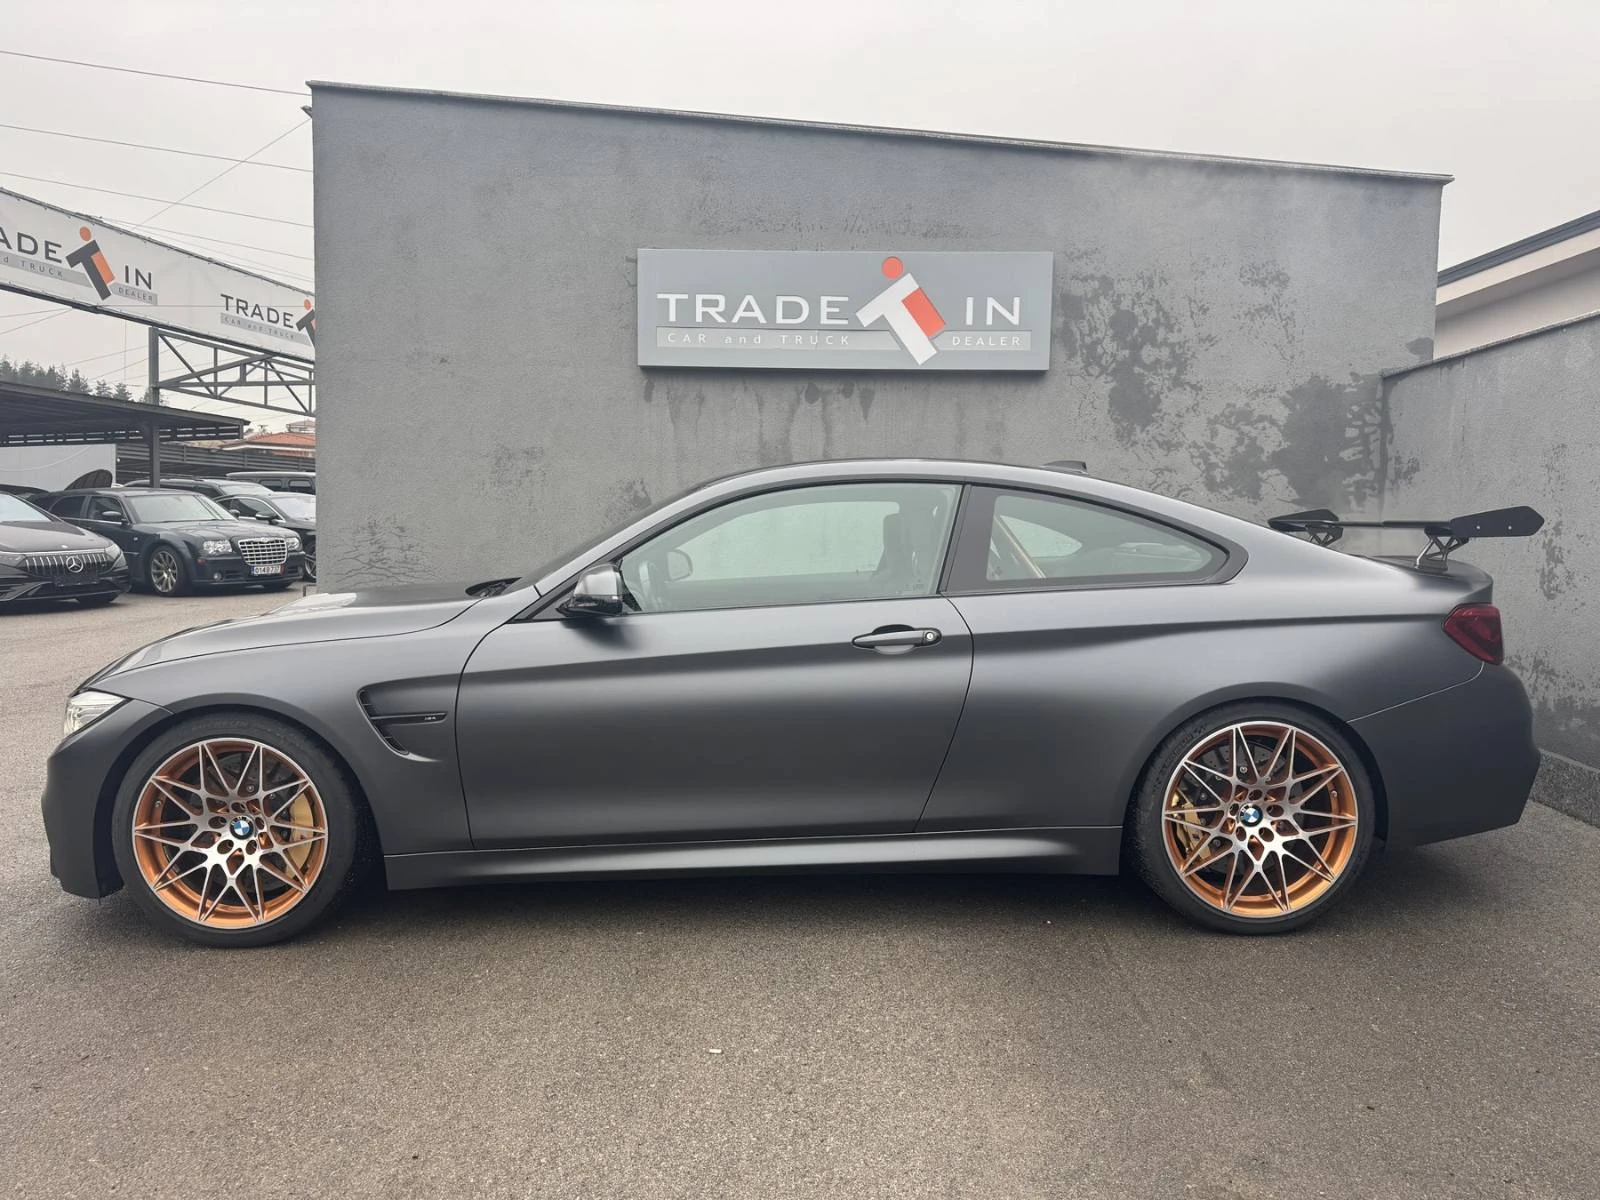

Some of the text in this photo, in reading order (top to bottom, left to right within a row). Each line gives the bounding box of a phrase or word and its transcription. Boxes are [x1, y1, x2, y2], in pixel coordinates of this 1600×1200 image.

[19, 260, 63, 279] TRUCK
[118, 287, 153, 302] DEALER
[124, 265, 152, 290] IN
[220, 293, 293, 329] TRADE
[656, 292, 849, 325] TRADE
[965, 296, 1021, 326] IN
[667, 332, 1022, 348] CAR and TRUCK DEALER
